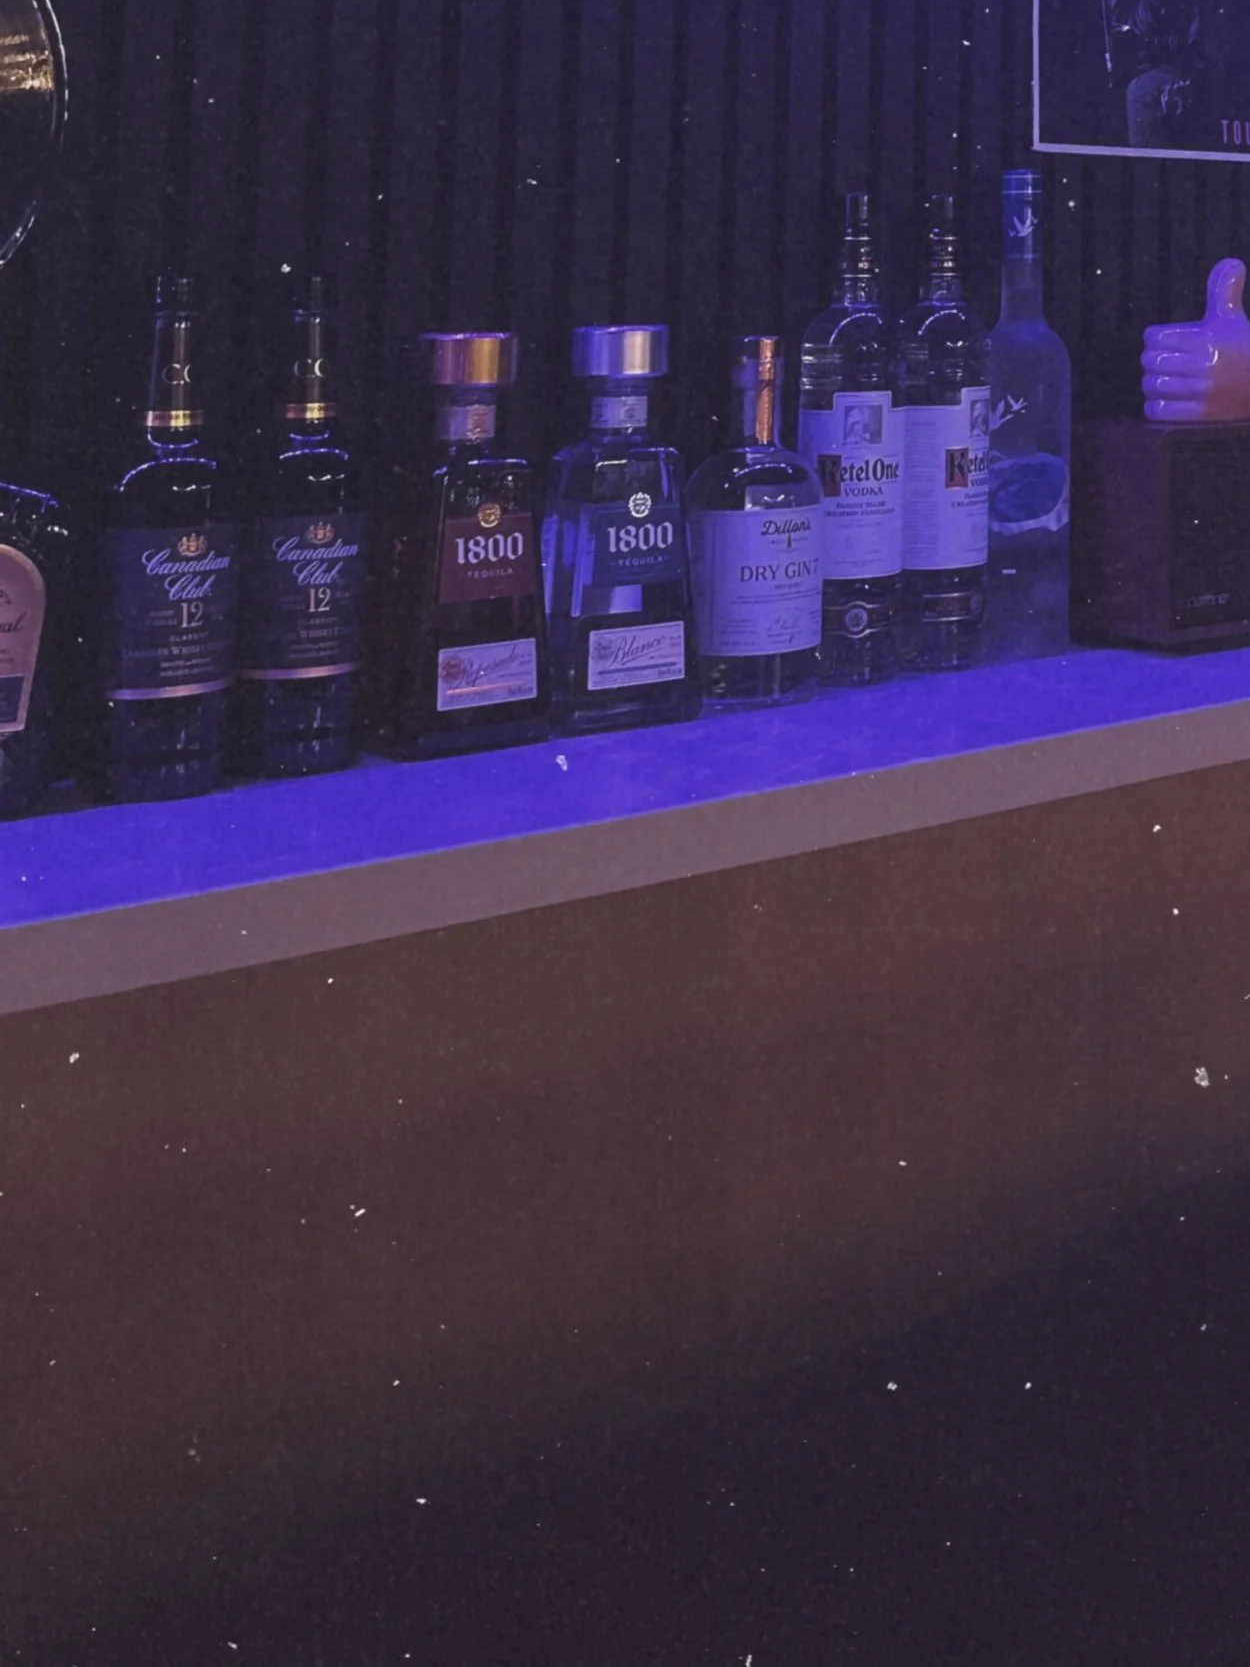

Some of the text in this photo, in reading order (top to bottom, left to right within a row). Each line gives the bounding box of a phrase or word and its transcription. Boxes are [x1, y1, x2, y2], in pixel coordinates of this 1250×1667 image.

[843, 485, 884, 498] VODKA
[272, 536, 359, 562] Canadian
[454, 532, 524, 565] 1800
[607, 521, 674, 554] 1800
[142, 548, 231, 575] Canadian
[292, 560, 344, 586] Club
[467, 567, 514, 579] TEQUILA
[617, 555, 664, 567] TEQUILA
[739, 563, 780, 582] DRY
[784, 560, 811, 579] GIN
[165, 574, 217, 601] Club
[308, 587, 332, 613] 12
[180, 601, 204, 628] 12
[607, 635, 666, 667] Blanco
